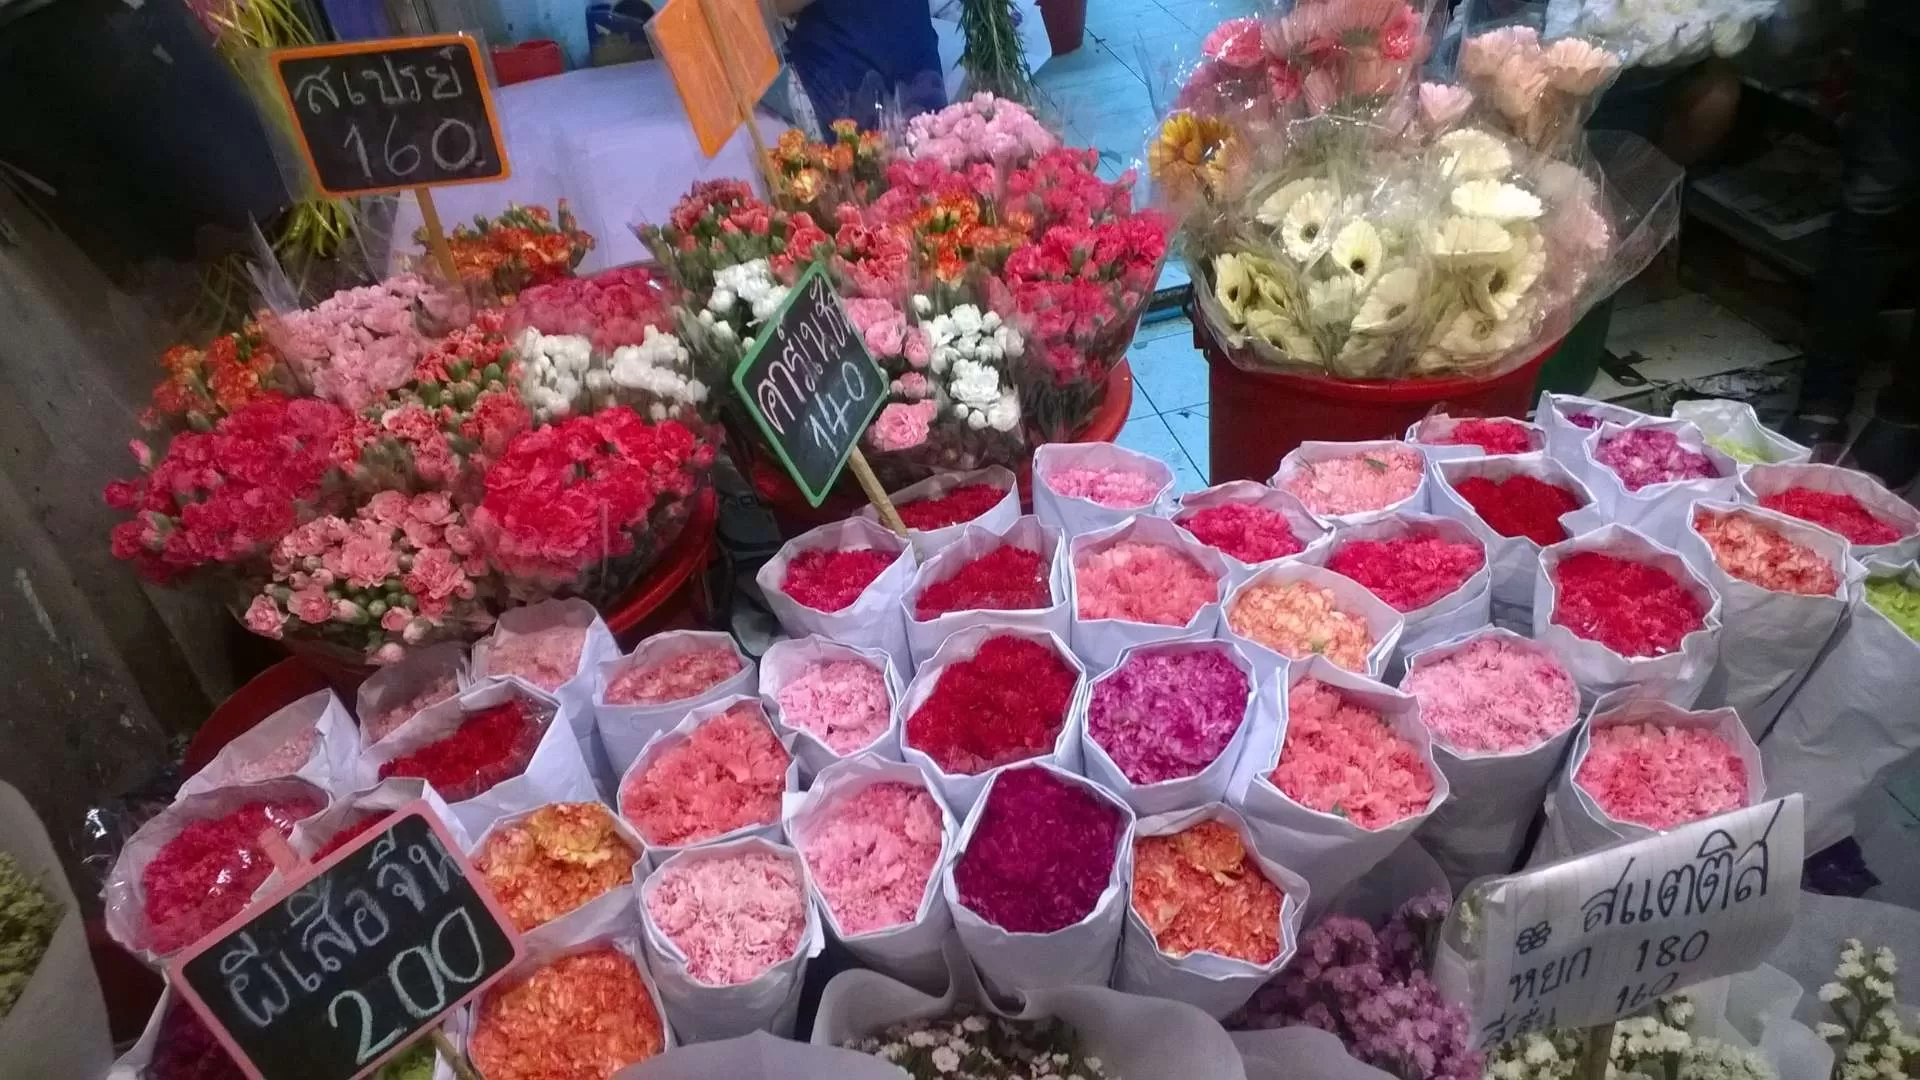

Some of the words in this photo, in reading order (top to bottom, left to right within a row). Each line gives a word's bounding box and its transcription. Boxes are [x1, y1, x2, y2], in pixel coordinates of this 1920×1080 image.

[809, 361, 866, 459] 140
[328, 907, 484, 1065] 200
[1636, 930, 1710, 972] 180
[1616, 972, 1679, 1013] 160
